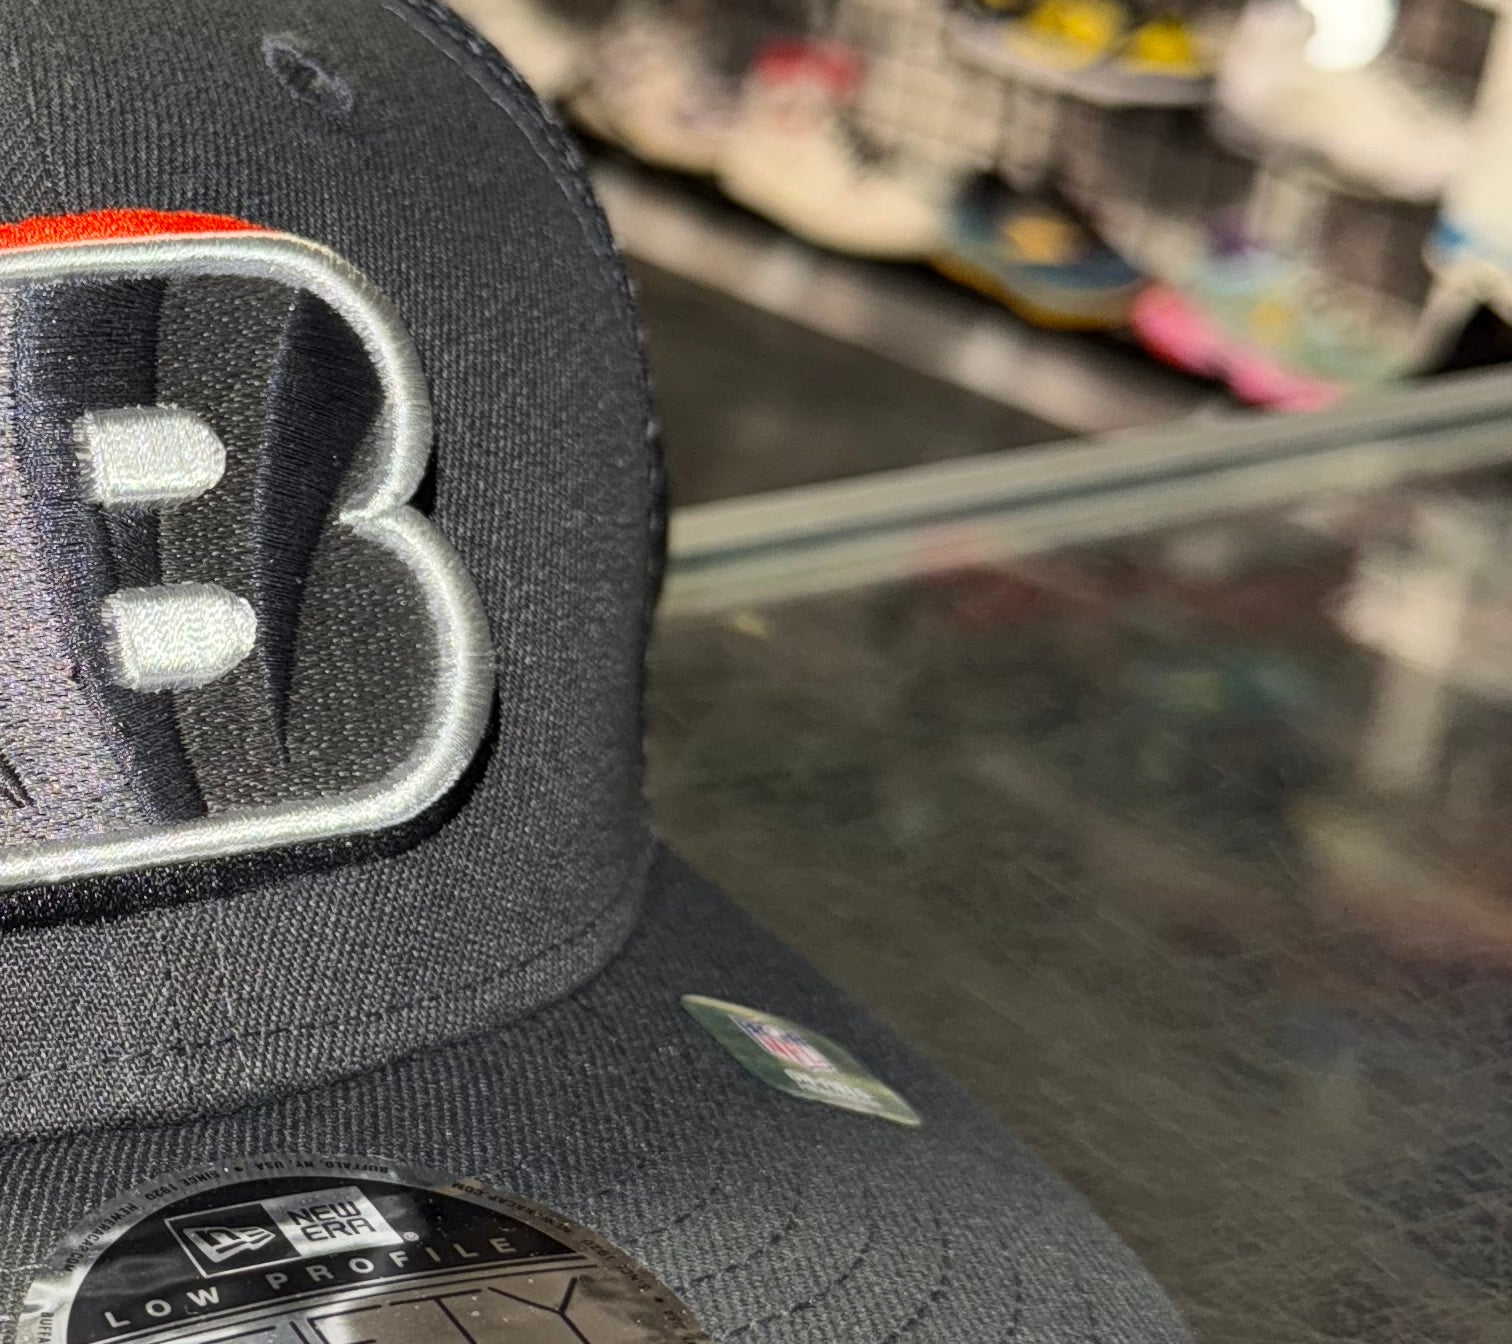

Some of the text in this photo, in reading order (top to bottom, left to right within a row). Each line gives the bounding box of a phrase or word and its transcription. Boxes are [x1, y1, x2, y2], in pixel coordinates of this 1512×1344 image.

[255, 1160, 285, 1172] USA
[144, 1169, 222, 1201] SINCE 1920
[287, 1200, 362, 1226] NEW
[300, 1217, 376, 1242] ERA
[103, 1236, 517, 1329] LOW PROFILE
